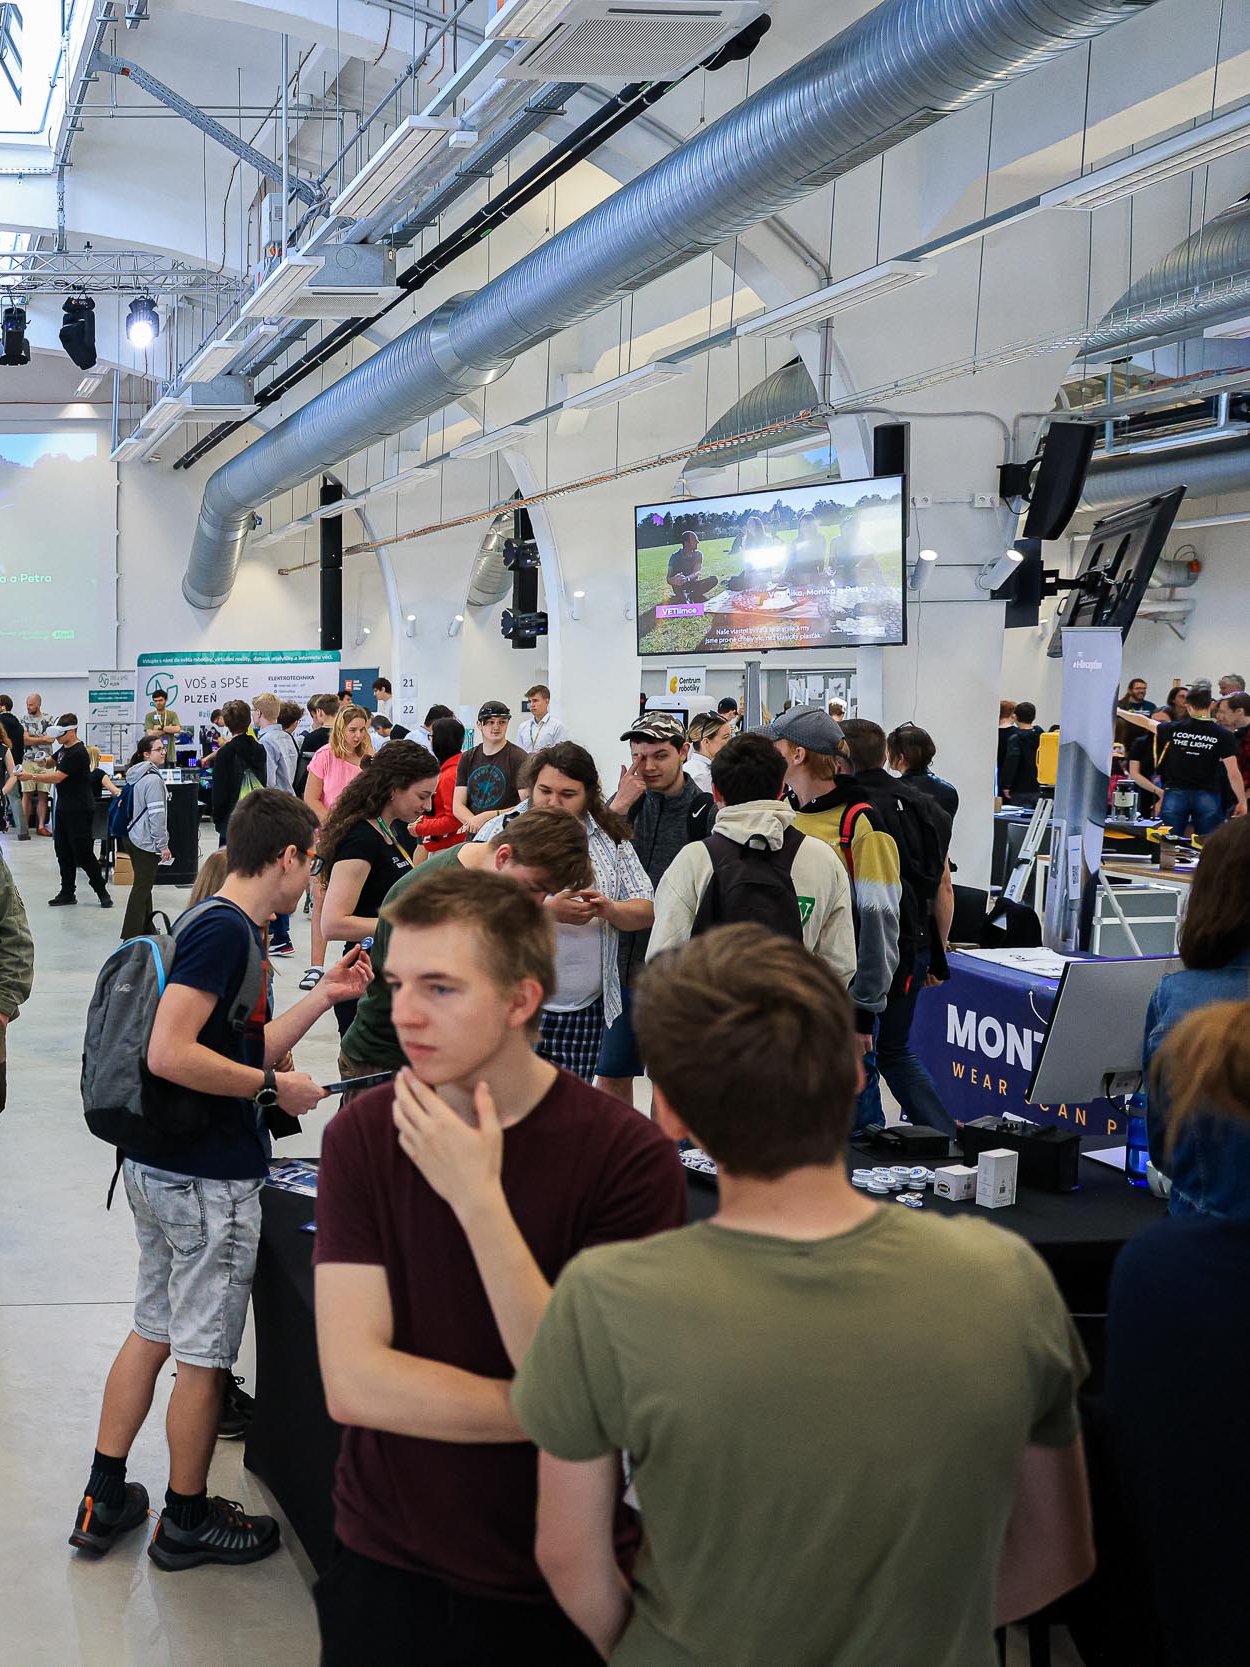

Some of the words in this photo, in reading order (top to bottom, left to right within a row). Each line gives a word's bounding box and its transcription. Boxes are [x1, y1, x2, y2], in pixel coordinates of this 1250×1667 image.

[20, 574, 52, 584] Petra
[806, 588, 835, 596] Monika
[184, 675, 206, 689] VOŠ
[210, 680, 216, 689] a
[220, 675, 249, 688] SPŠE
[403, 679, 414, 687] 21
[679, 684, 700, 693] robotiky
[184, 692, 217, 704] PLZEŇ
[403, 706, 414, 714] 22
[1176, 732, 1218, 743] COMMAND
[1173, 738, 1189, 746] THE
[1189, 741, 1214, 750] LIGHT
[952, 1061, 1008, 1096] WEAR
